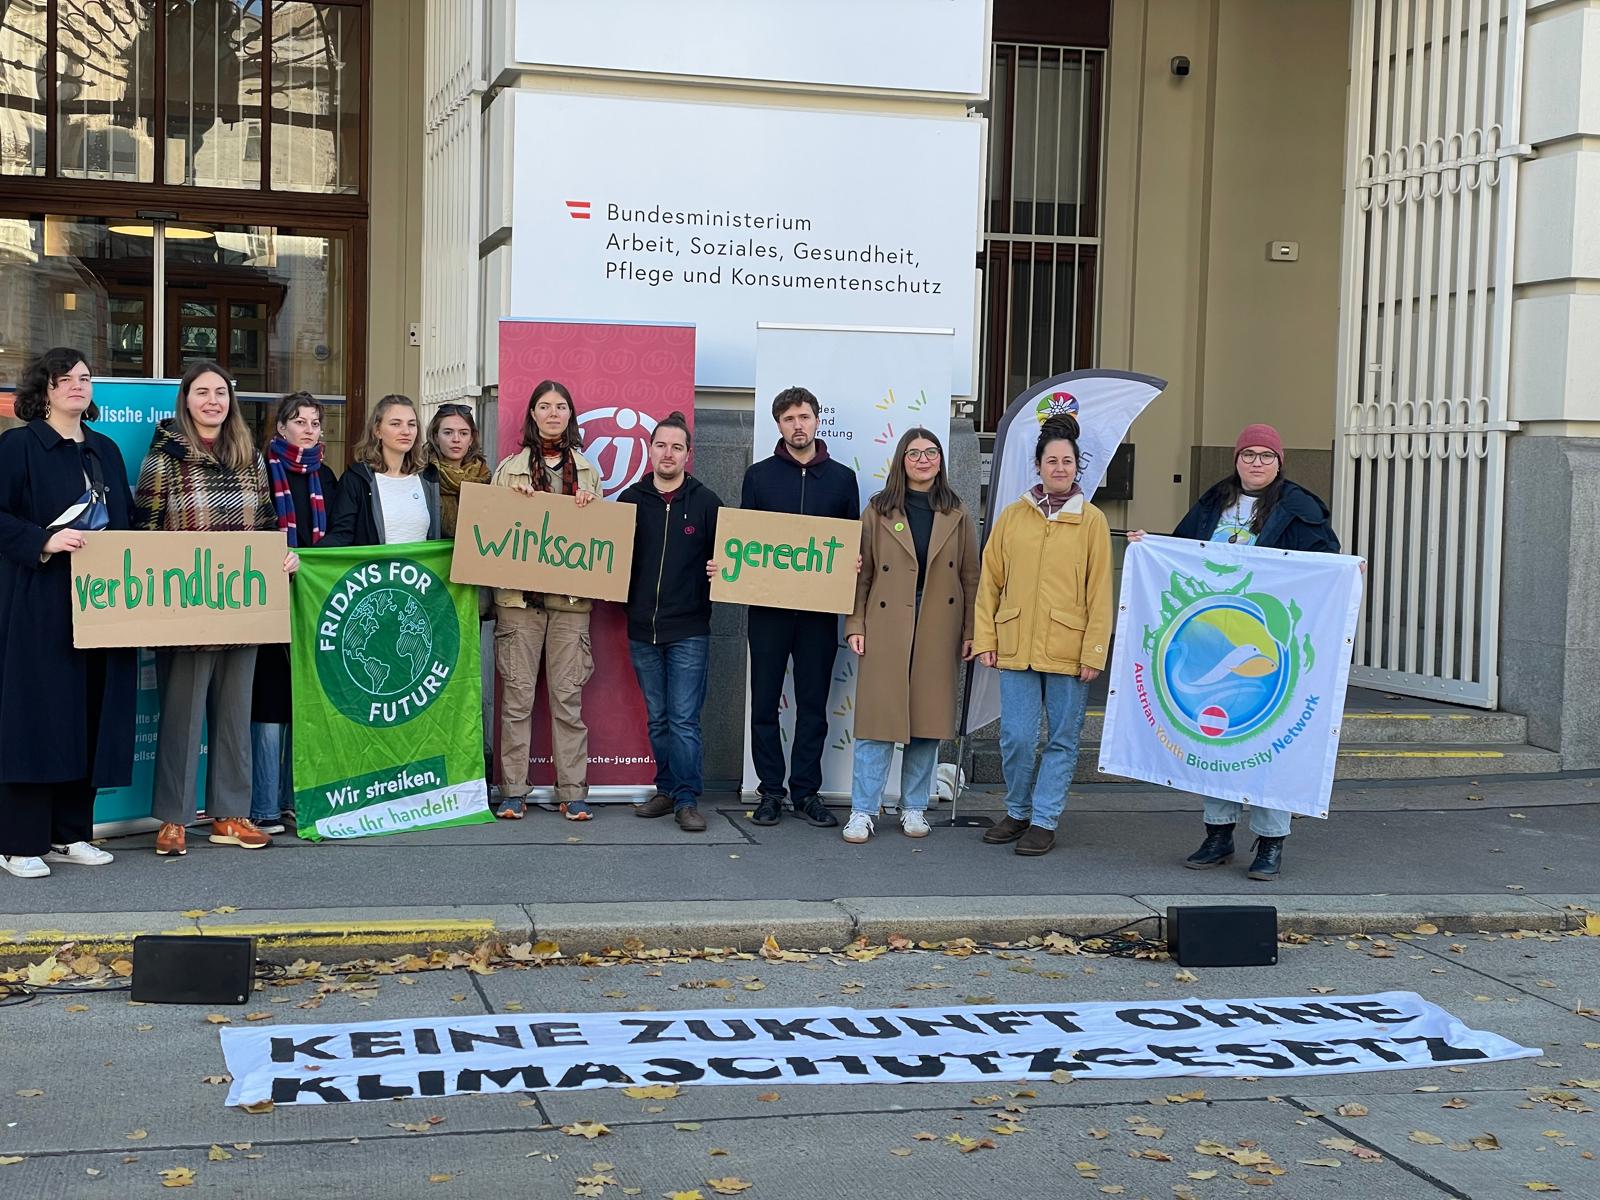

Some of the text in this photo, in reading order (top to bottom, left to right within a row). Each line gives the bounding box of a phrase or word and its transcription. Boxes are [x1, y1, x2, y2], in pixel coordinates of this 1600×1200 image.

[606, 203, 812, 231] Bundesministerium
[606, 233, 920, 268] Arbeit, Soziales, Gesundheit,
[606, 262, 942, 295] Pflege und Konsumentenschutz
[99, 406, 143, 423] lische
[818, 404, 836, 414] des
[816, 429, 853, 441] retung
[473, 511, 614, 573] wirksam
[721, 536, 844, 583] gerecht
[75, 545, 267, 611] verbindlich
[319, 561, 433, 652] FRIDAYS FOR
[368, 660, 450, 722] FUTURE
[1134, 662, 1321, 774] Austrian Youth Biodiversity Network
[325, 770, 441, 809] Wir streiken,
[359, 814, 384, 832] Ihr
[387, 793, 460, 824] handelt!
[270, 1001, 1421, 1063] KEINE ZUKUNFT OHNE
[271, 1036, 1490, 1103] KLIMASCHUTZGESETZ
